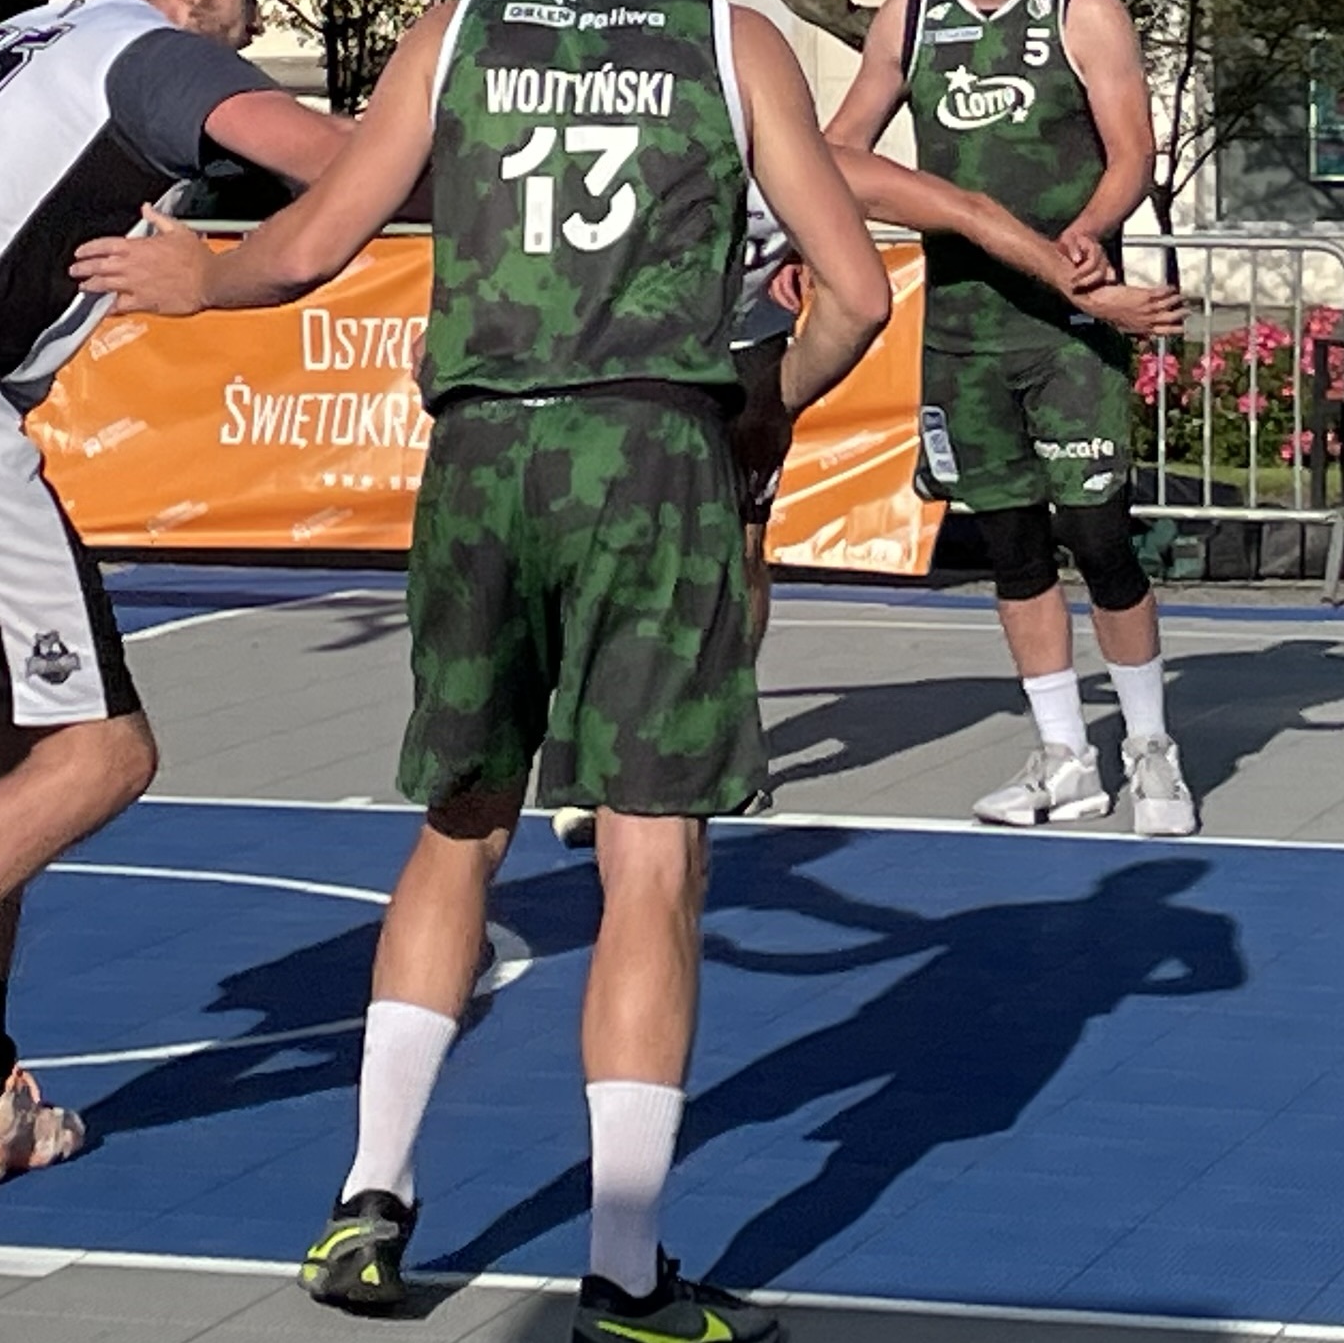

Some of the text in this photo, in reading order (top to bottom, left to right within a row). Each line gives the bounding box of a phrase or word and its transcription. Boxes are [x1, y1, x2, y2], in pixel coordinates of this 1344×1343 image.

[508, 6, 665, 30] ORLEN paliwa
[1022, 28, 1050, 66] 5
[486, 63, 674, 117] WOJTYŃSKI
[955, 87, 1016, 117] LOTTO
[502, 126, 639, 254] 13
